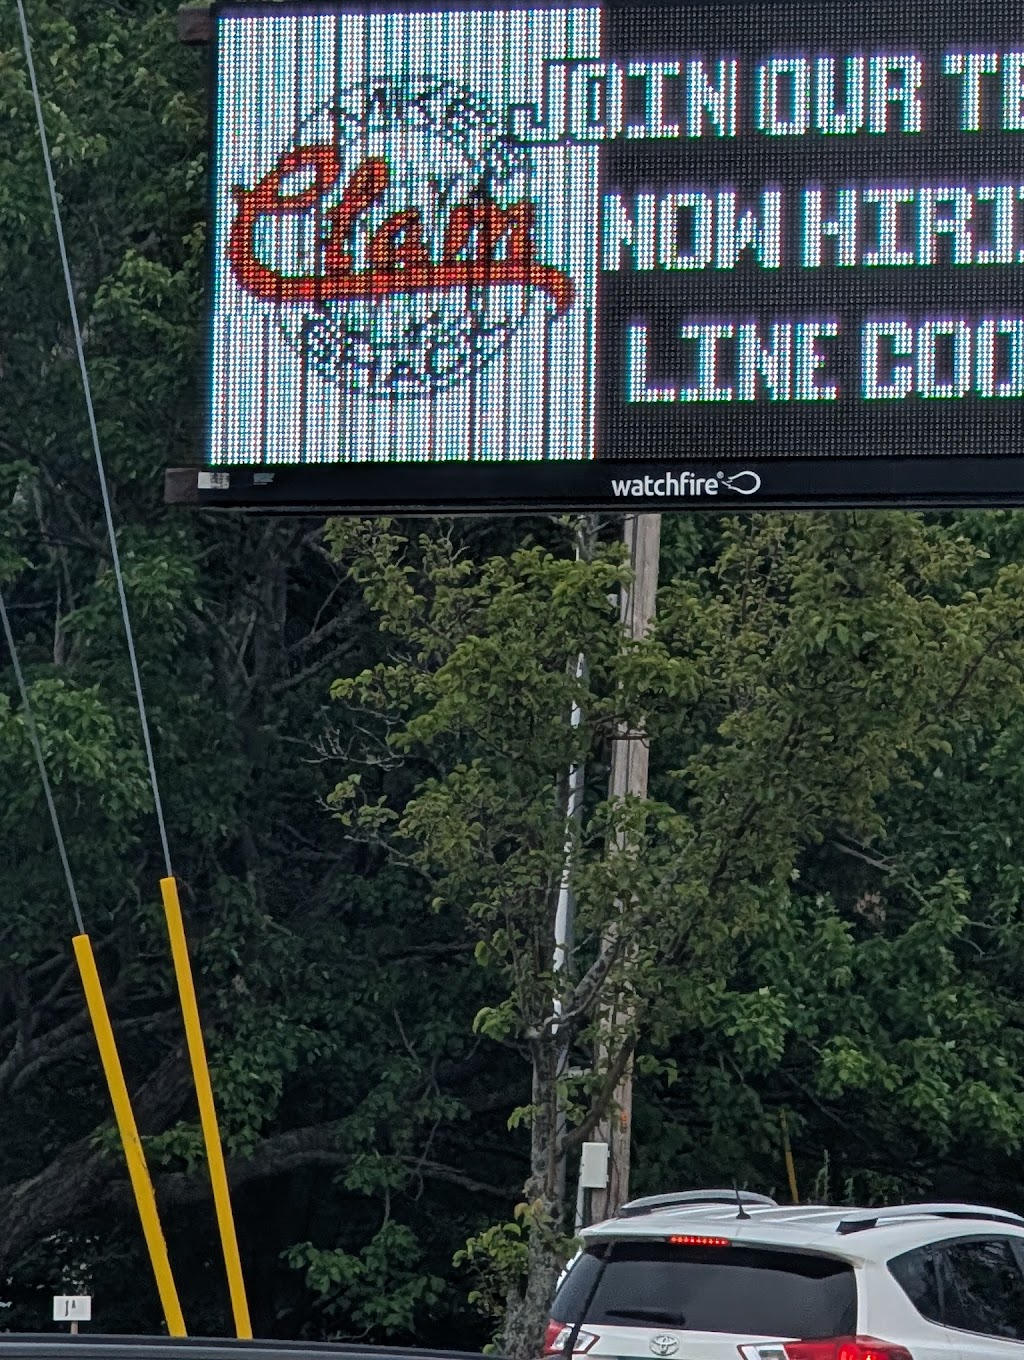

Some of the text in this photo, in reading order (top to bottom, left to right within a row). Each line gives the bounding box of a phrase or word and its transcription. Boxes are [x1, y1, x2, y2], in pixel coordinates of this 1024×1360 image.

[511, 58, 738, 140] JOIN
[758, 53, 924, 136] OUR
[230, 144, 575, 314] Clam
[602, 190, 782, 271] NOW
[625, 322, 839, 403] LINE
